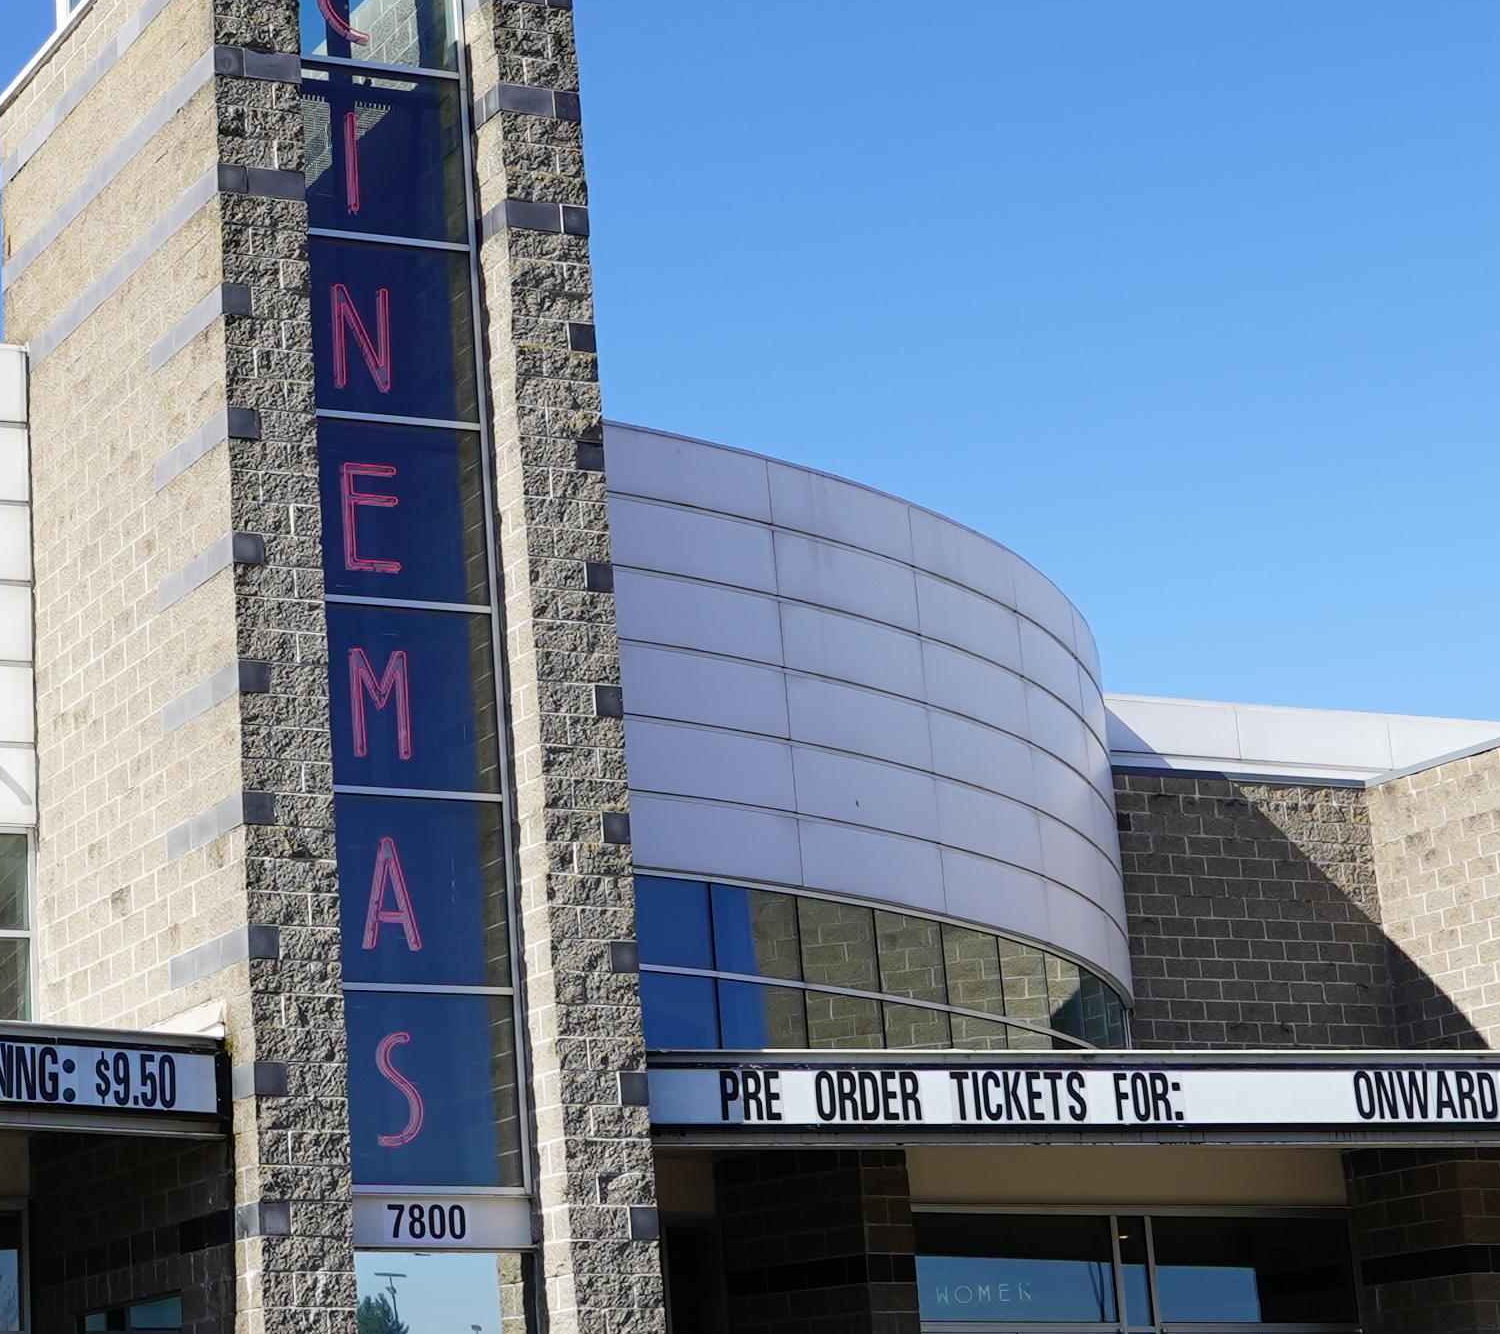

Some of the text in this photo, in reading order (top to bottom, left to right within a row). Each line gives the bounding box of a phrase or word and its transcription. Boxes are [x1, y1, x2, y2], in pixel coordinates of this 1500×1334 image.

[96, 1051, 176, 1108] $9.50
[719, 1071, 1184, 1121] PRE ORDER TICKETS FOR:
[1354, 1070, 1499, 1119] ONWARD
[387, 1204, 465, 1239] 7800
[936, 1283, 1032, 1304] WOMEN
